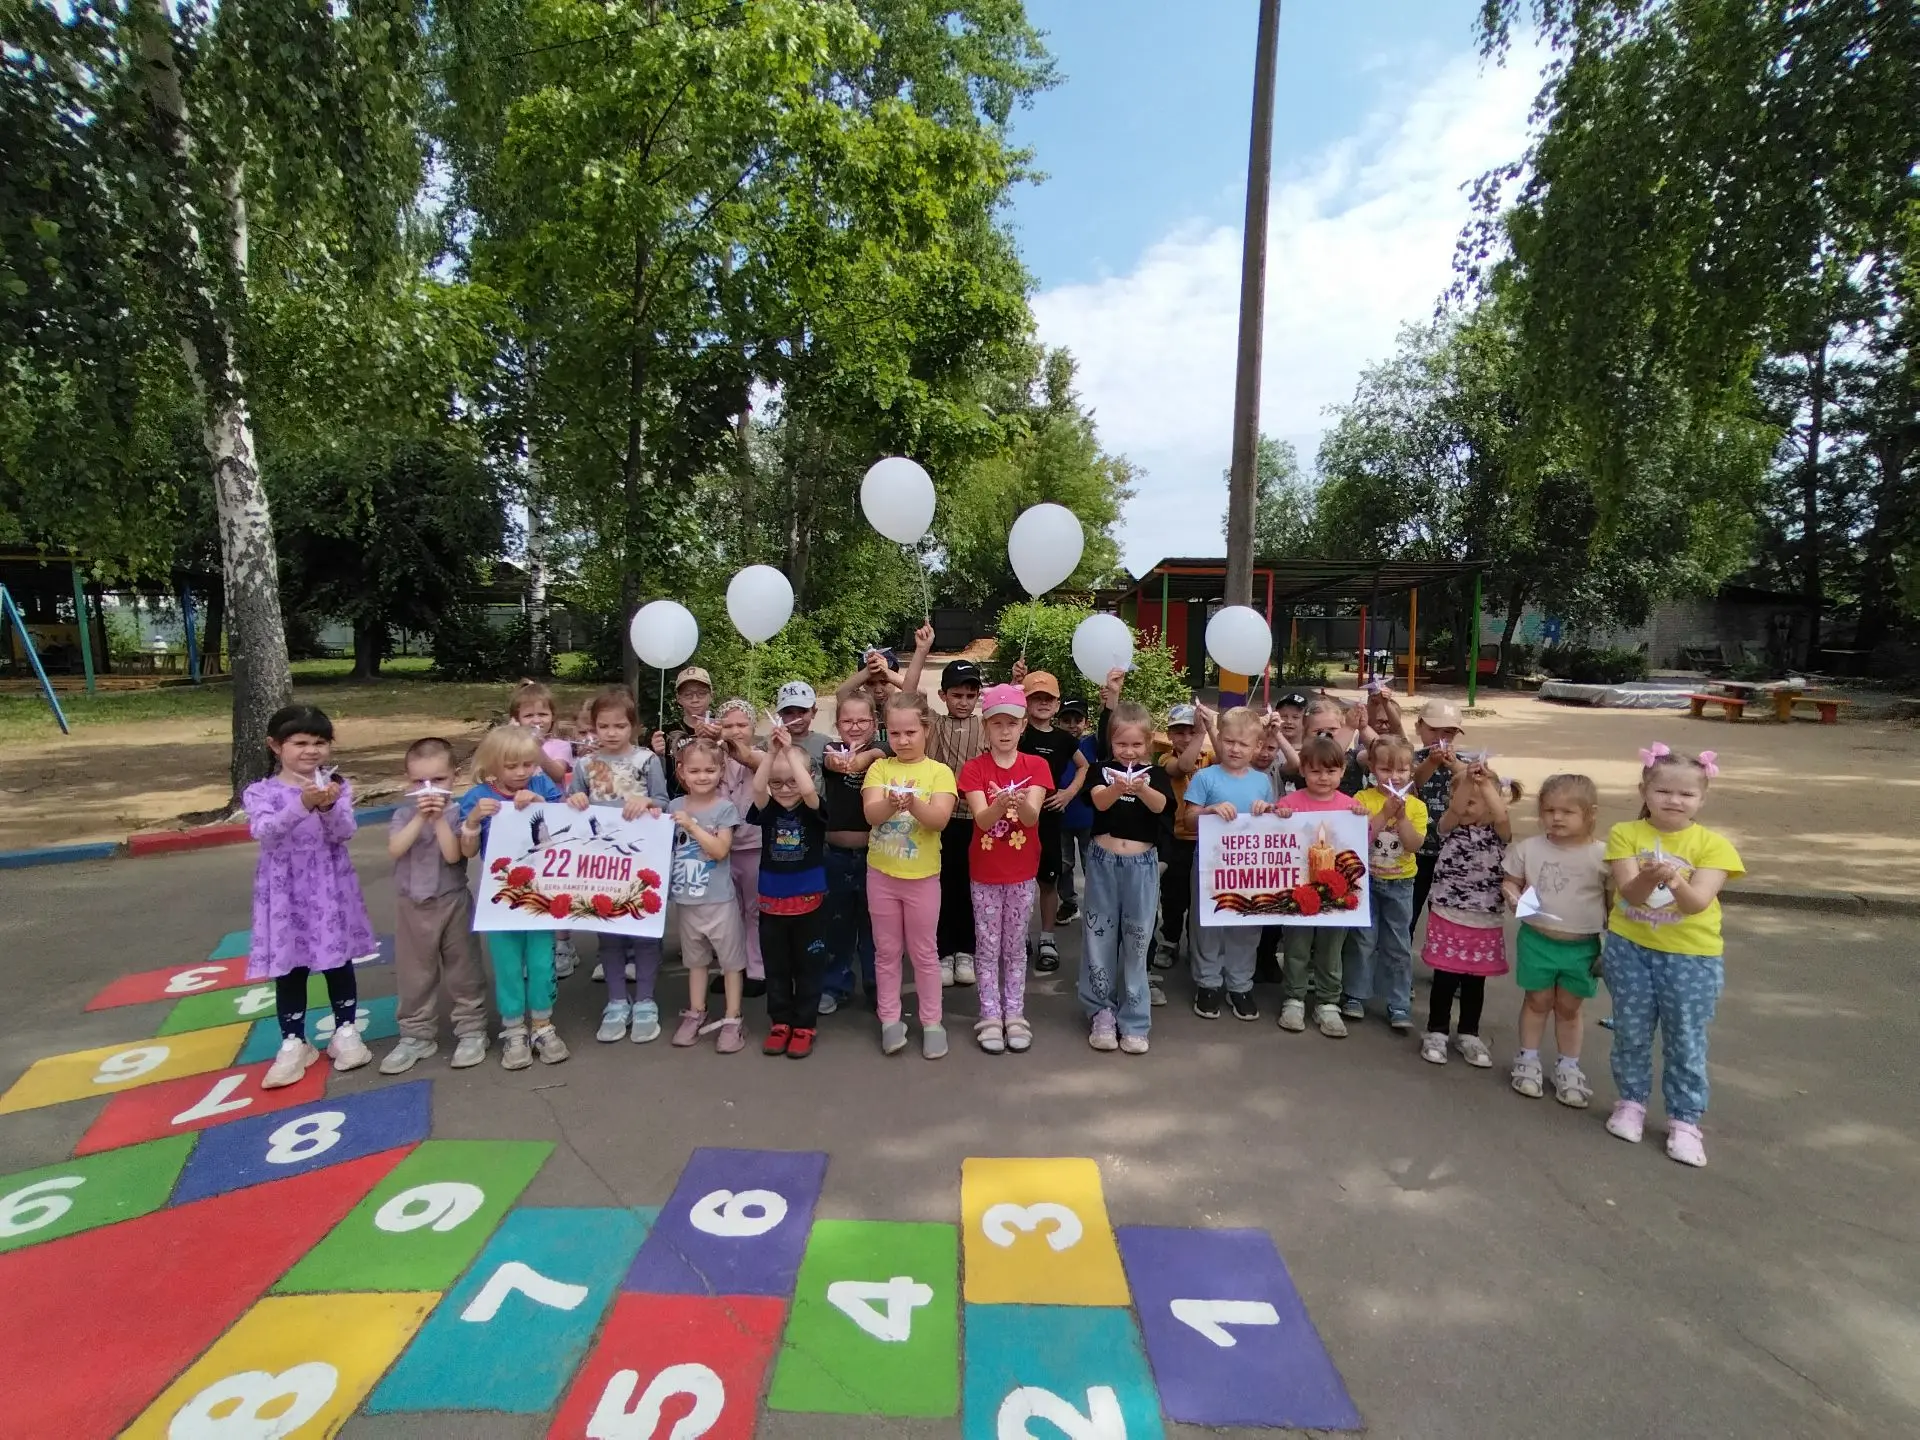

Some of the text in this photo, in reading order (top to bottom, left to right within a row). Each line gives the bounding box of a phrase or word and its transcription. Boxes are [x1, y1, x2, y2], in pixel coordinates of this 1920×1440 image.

[542, 849, 632, 881] 22 ИЮНЯ
[1222, 834, 1300, 850] ЧЕРЕЗ ВЕКА,
[1222, 852, 1258, 866] ЧЕРЕЗ
[1261, 851, 1292, 866] ГОДА
[1215, 868, 1300, 889] ПОМНИТЕ
[164, 965, 229, 993] 3
[171, 1073, 253, 1125] 7
[265, 1110, 346, 1164] 8
[982, 1202, 1083, 1252] 3
[461, 1261, 589, 1322] 7
[826, 1275, 934, 1343] 4
[1169, 1298, 1281, 1348] 1
[168, 1361, 338, 1440] 8
[585, 1363, 725, 1440] 5
[996, 1384, 1128, 1440] 2
